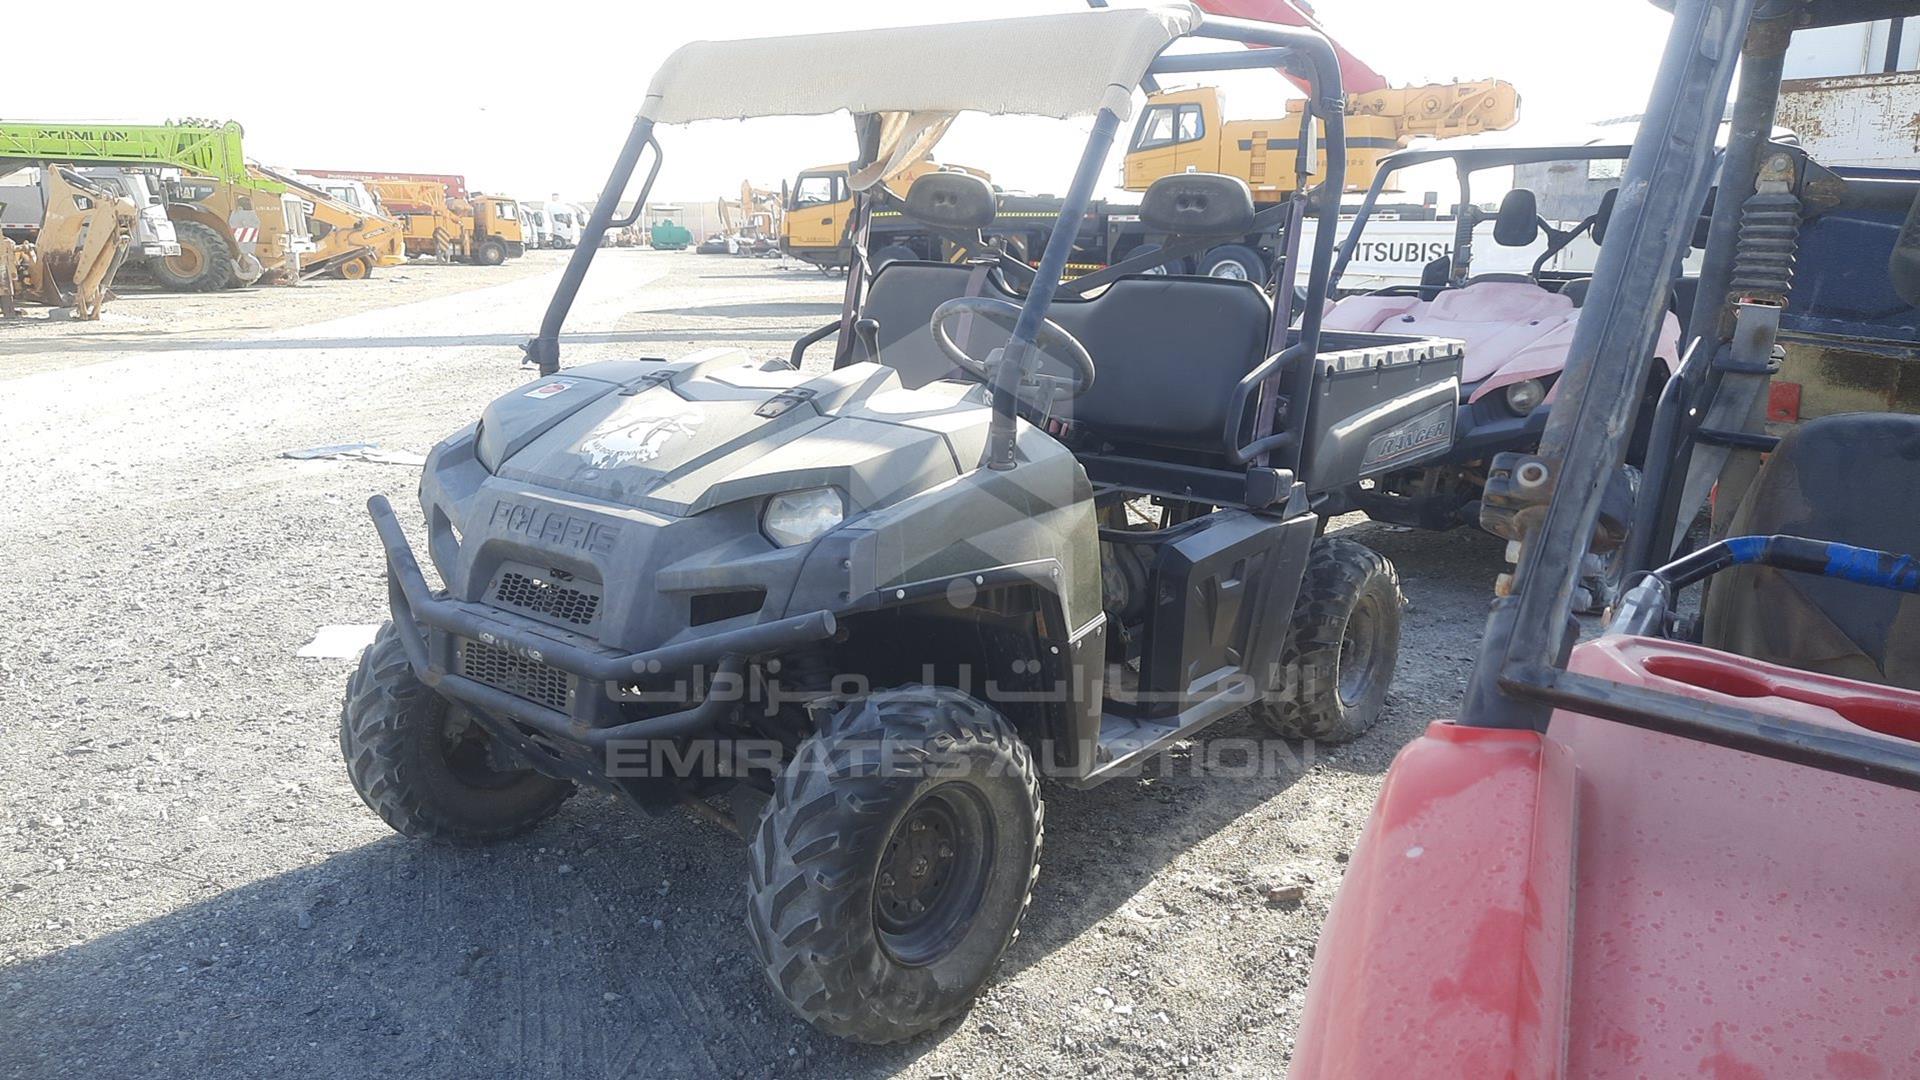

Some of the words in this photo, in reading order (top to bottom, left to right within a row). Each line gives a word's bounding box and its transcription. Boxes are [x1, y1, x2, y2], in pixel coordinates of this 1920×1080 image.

[1354, 242, 1454, 262] ITSUBISH
[1380, 421, 1447, 455] RANGER
[489, 500, 621, 557] POLARIS
